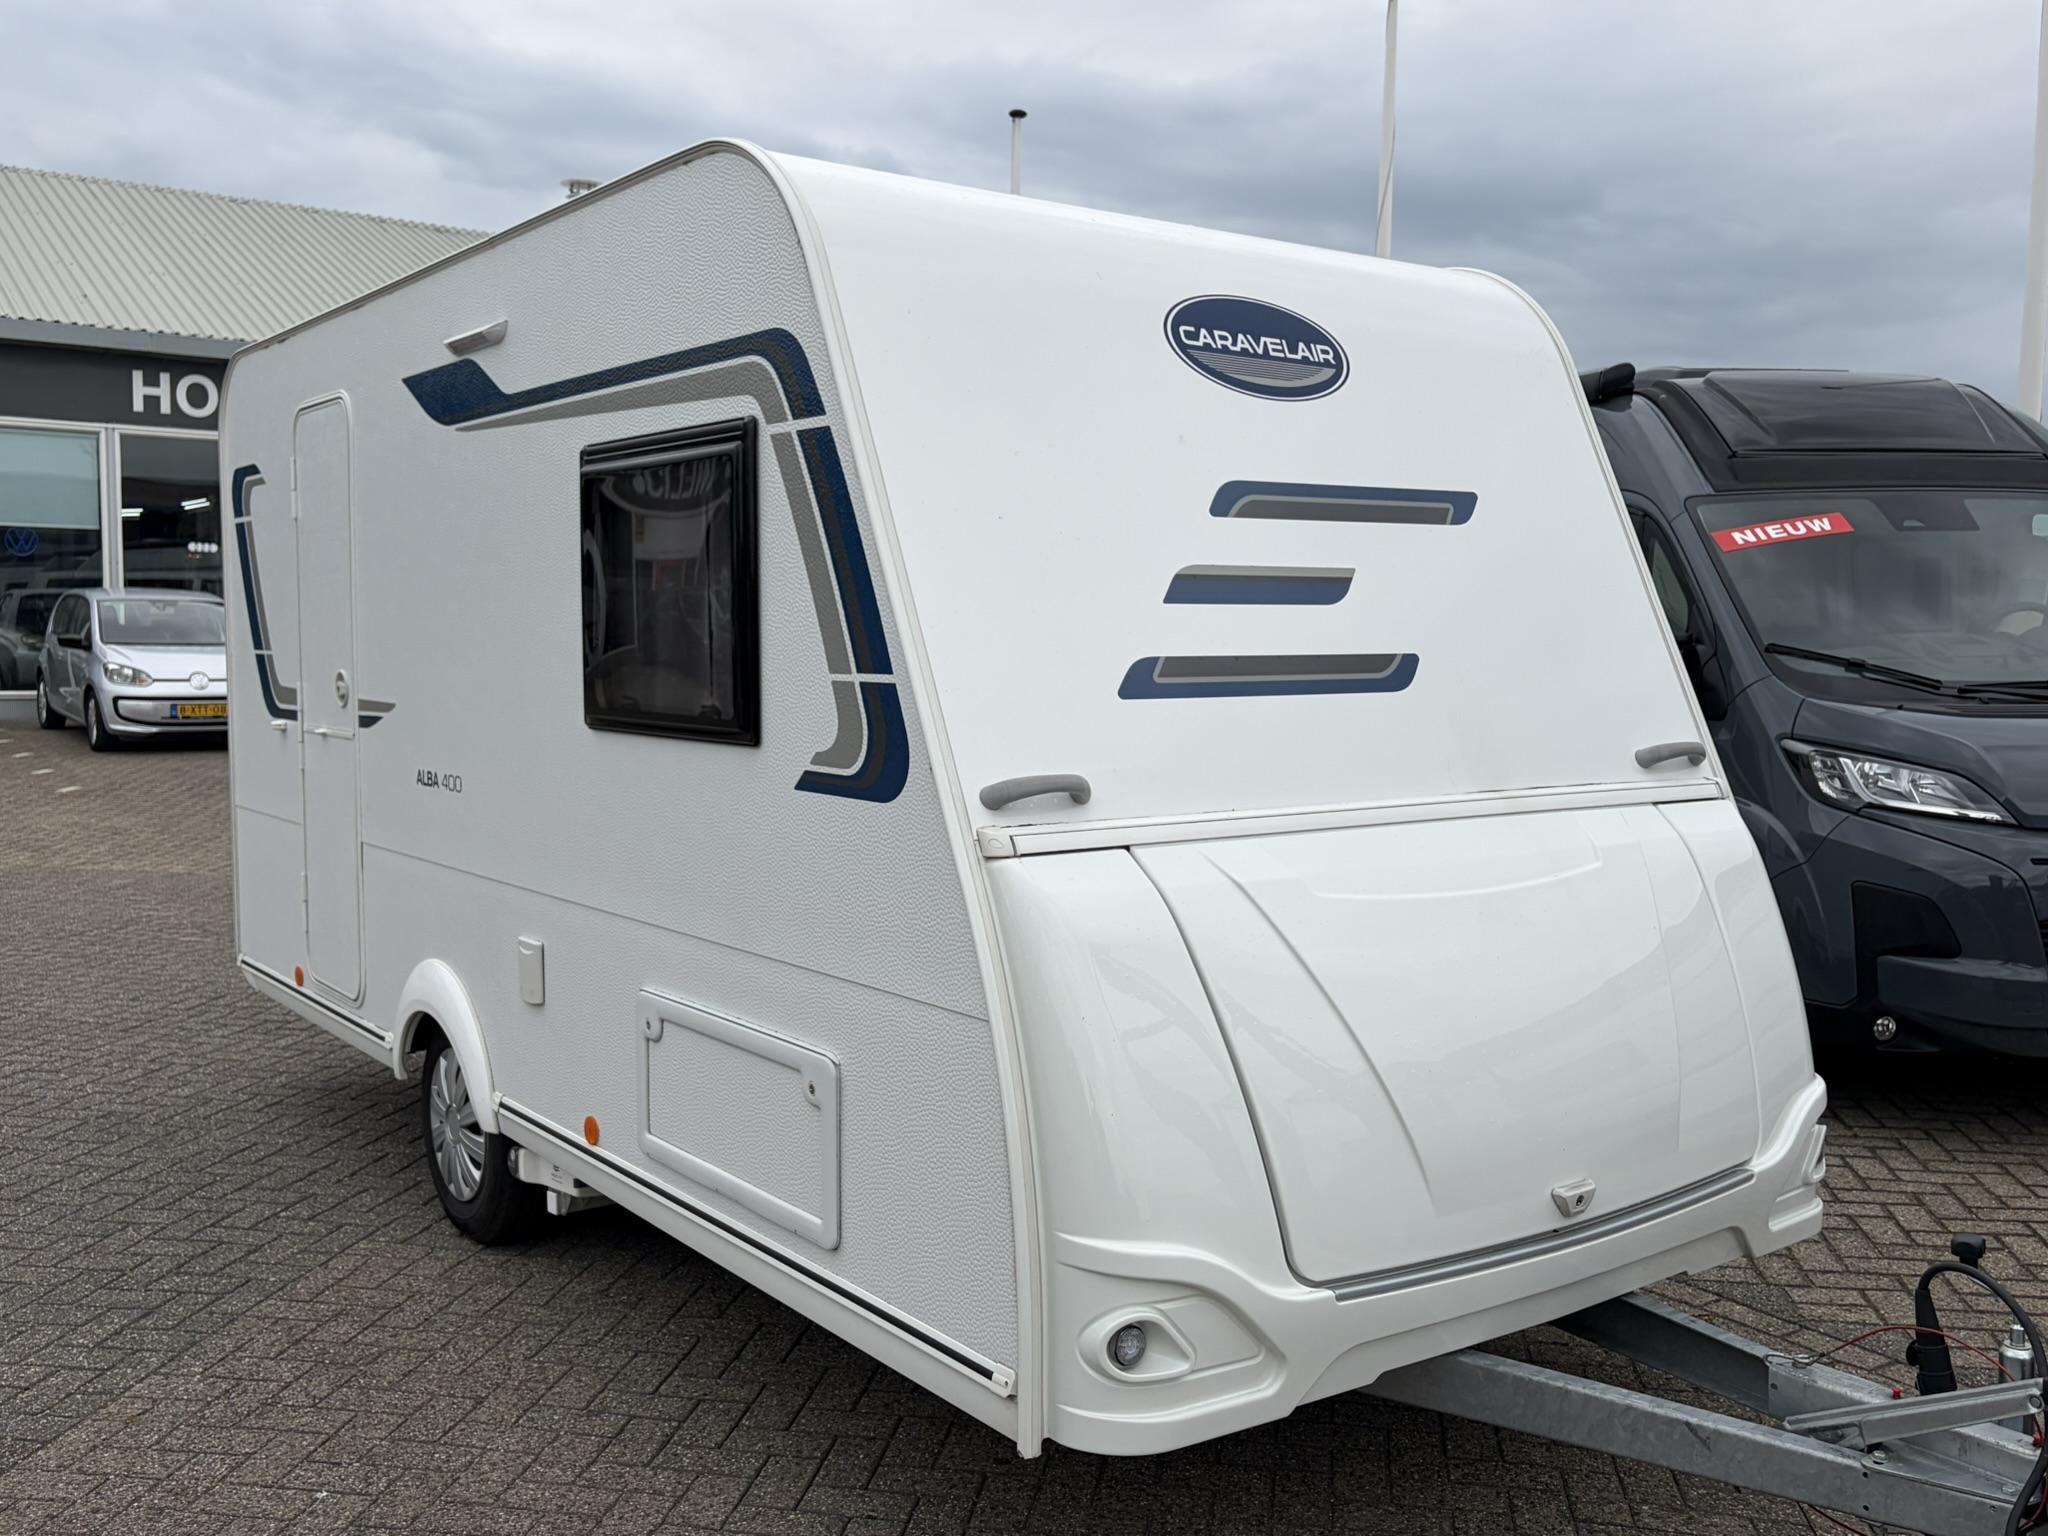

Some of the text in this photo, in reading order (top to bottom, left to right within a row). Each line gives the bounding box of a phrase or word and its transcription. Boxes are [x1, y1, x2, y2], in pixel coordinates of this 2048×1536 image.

[1178, 325, 1337, 365] CARAVELAIR
[1730, 517, 1833, 545] NIEUW
[416, 769, 463, 793] ALBA 400
